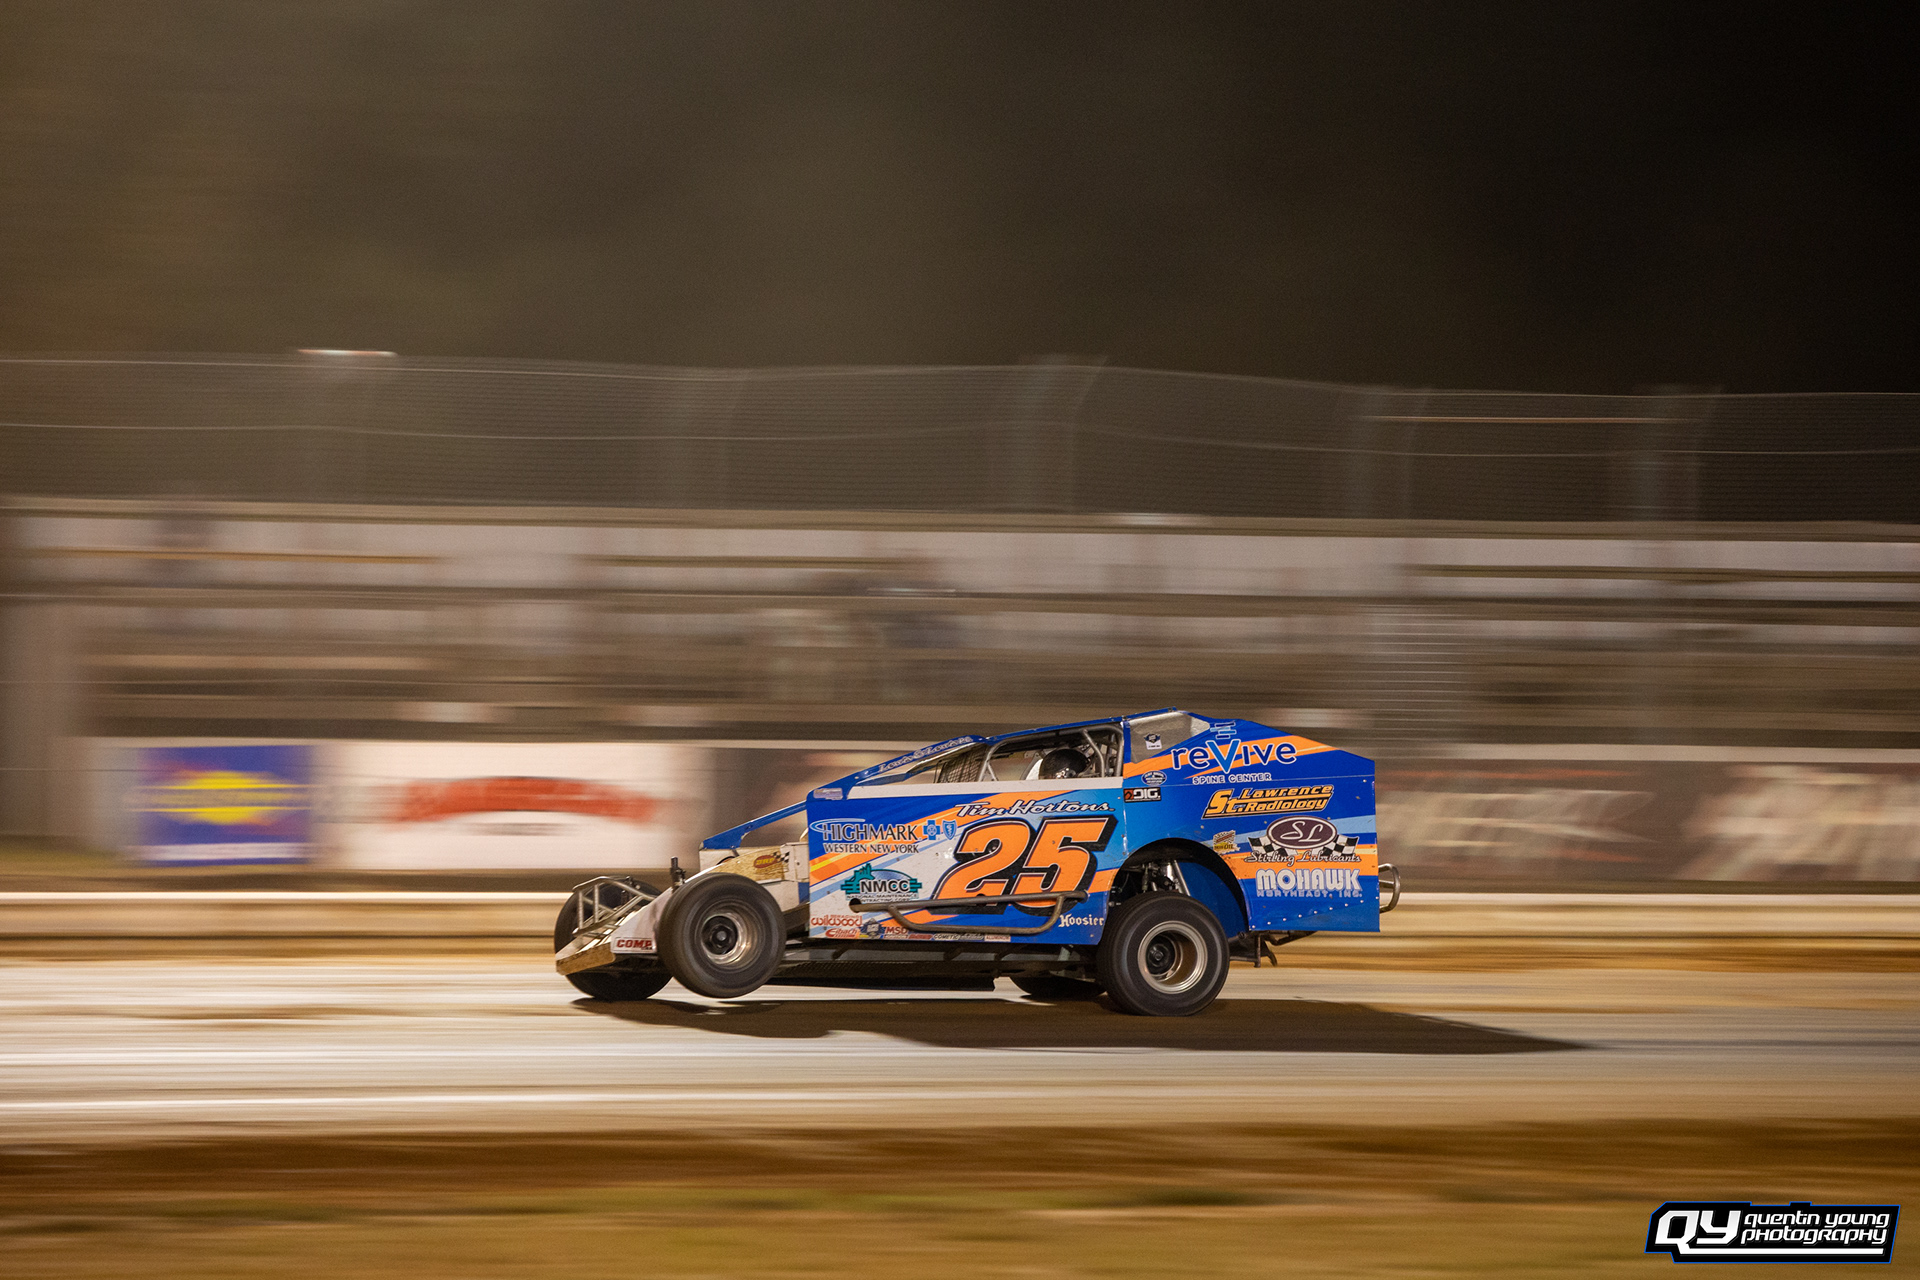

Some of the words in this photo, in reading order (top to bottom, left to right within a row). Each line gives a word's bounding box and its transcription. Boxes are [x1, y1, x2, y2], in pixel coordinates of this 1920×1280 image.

[1192, 775, 1226, 785] SPINE
[1229, 772, 1272, 783] CENTER
[1206, 788, 1246, 814] St.
[1240, 785, 1334, 799] Lawrence
[1244, 798, 1328, 812] Radiology
[955, 801, 1005, 818] Tim
[822, 823, 918, 841] HIGHMARK
[823, 842, 867, 853] WESTERN
[869, 843, 892, 853] NEW
[894, 843, 919, 854] YORK
[928, 818, 1114, 912] 25
[1244, 851, 1295, 866] Stirling
[1297, 851, 1362, 863] Lubricants
[1256, 868, 1363, 891] MOHAWK
[860, 880, 911, 894] NMCC
[811, 914, 863, 927] wilwood
[1058, 914, 1105, 928] Hoosier
[616, 939, 653, 949] COMP
